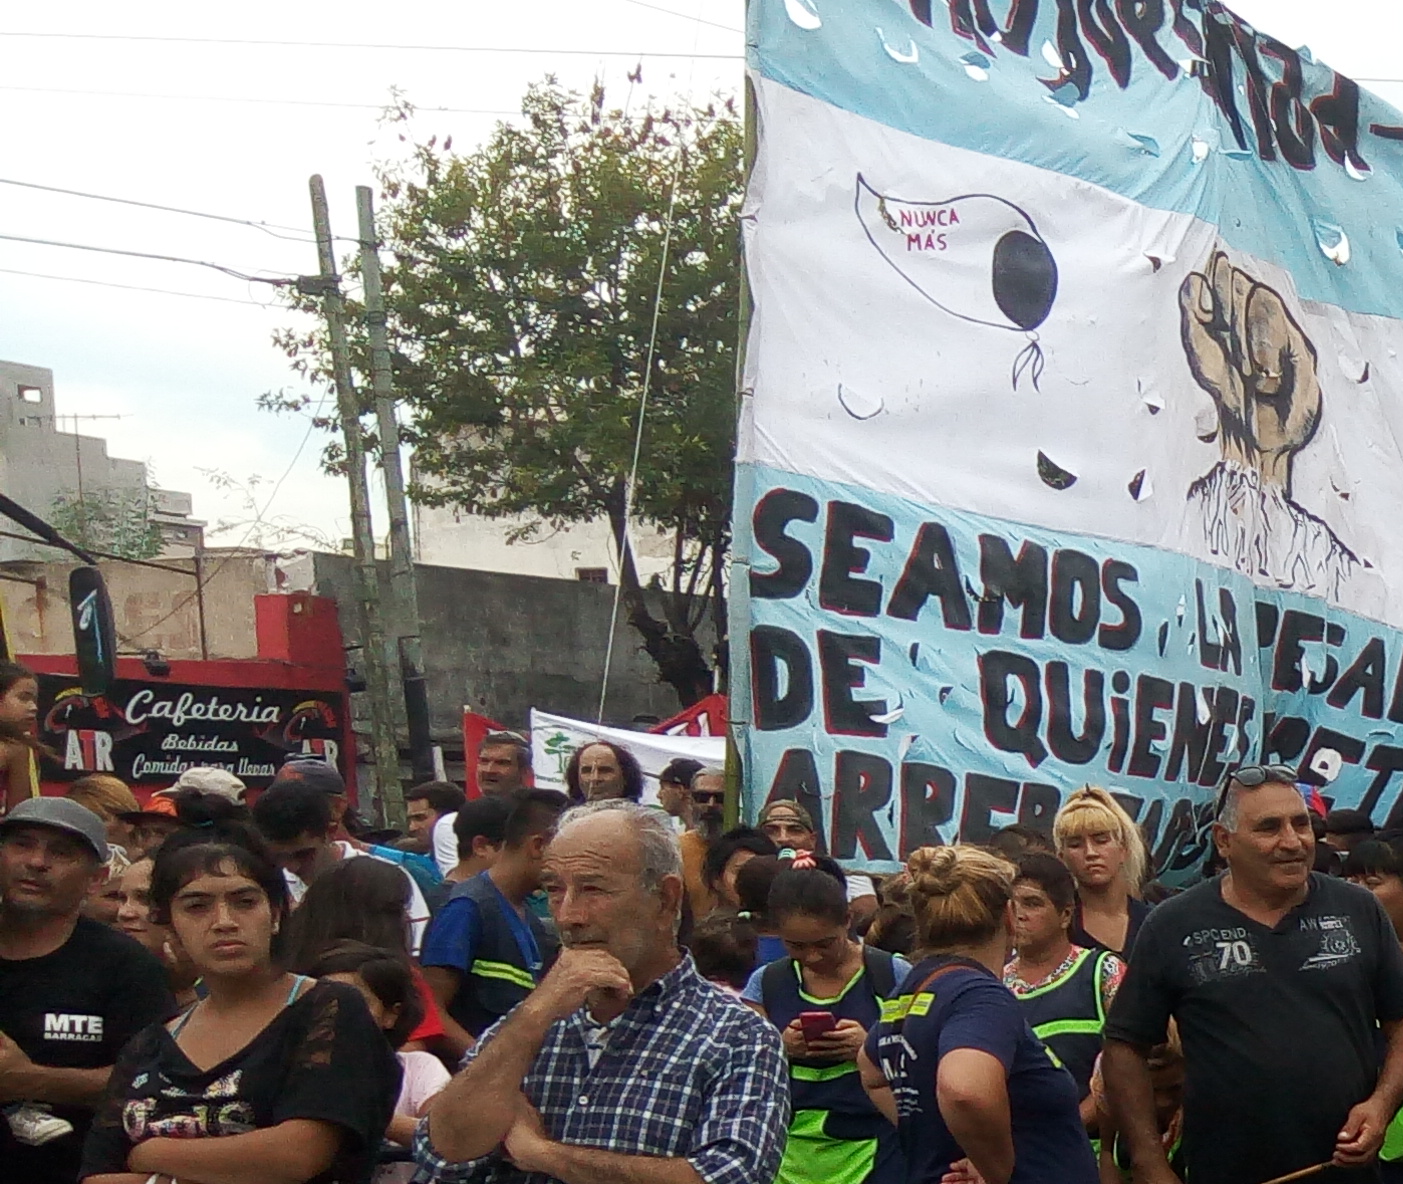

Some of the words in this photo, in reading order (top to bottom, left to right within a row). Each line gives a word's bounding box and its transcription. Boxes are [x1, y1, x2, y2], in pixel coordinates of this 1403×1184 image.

[900, 208, 961, 228] NUNCA
[906, 228, 949, 252] MÁS
[748, 488, 1143, 653] SEAMOS
[752, 625, 889, 738] DE
[125, 689, 281, 727] Cafeteria
[64, 729, 115, 772] ATR
[161, 734, 239, 752] Bebidas
[132, 753, 196, 779] Comidas
[1214, 940, 1252, 971] 70
[45, 1013, 103, 1034] MTE
